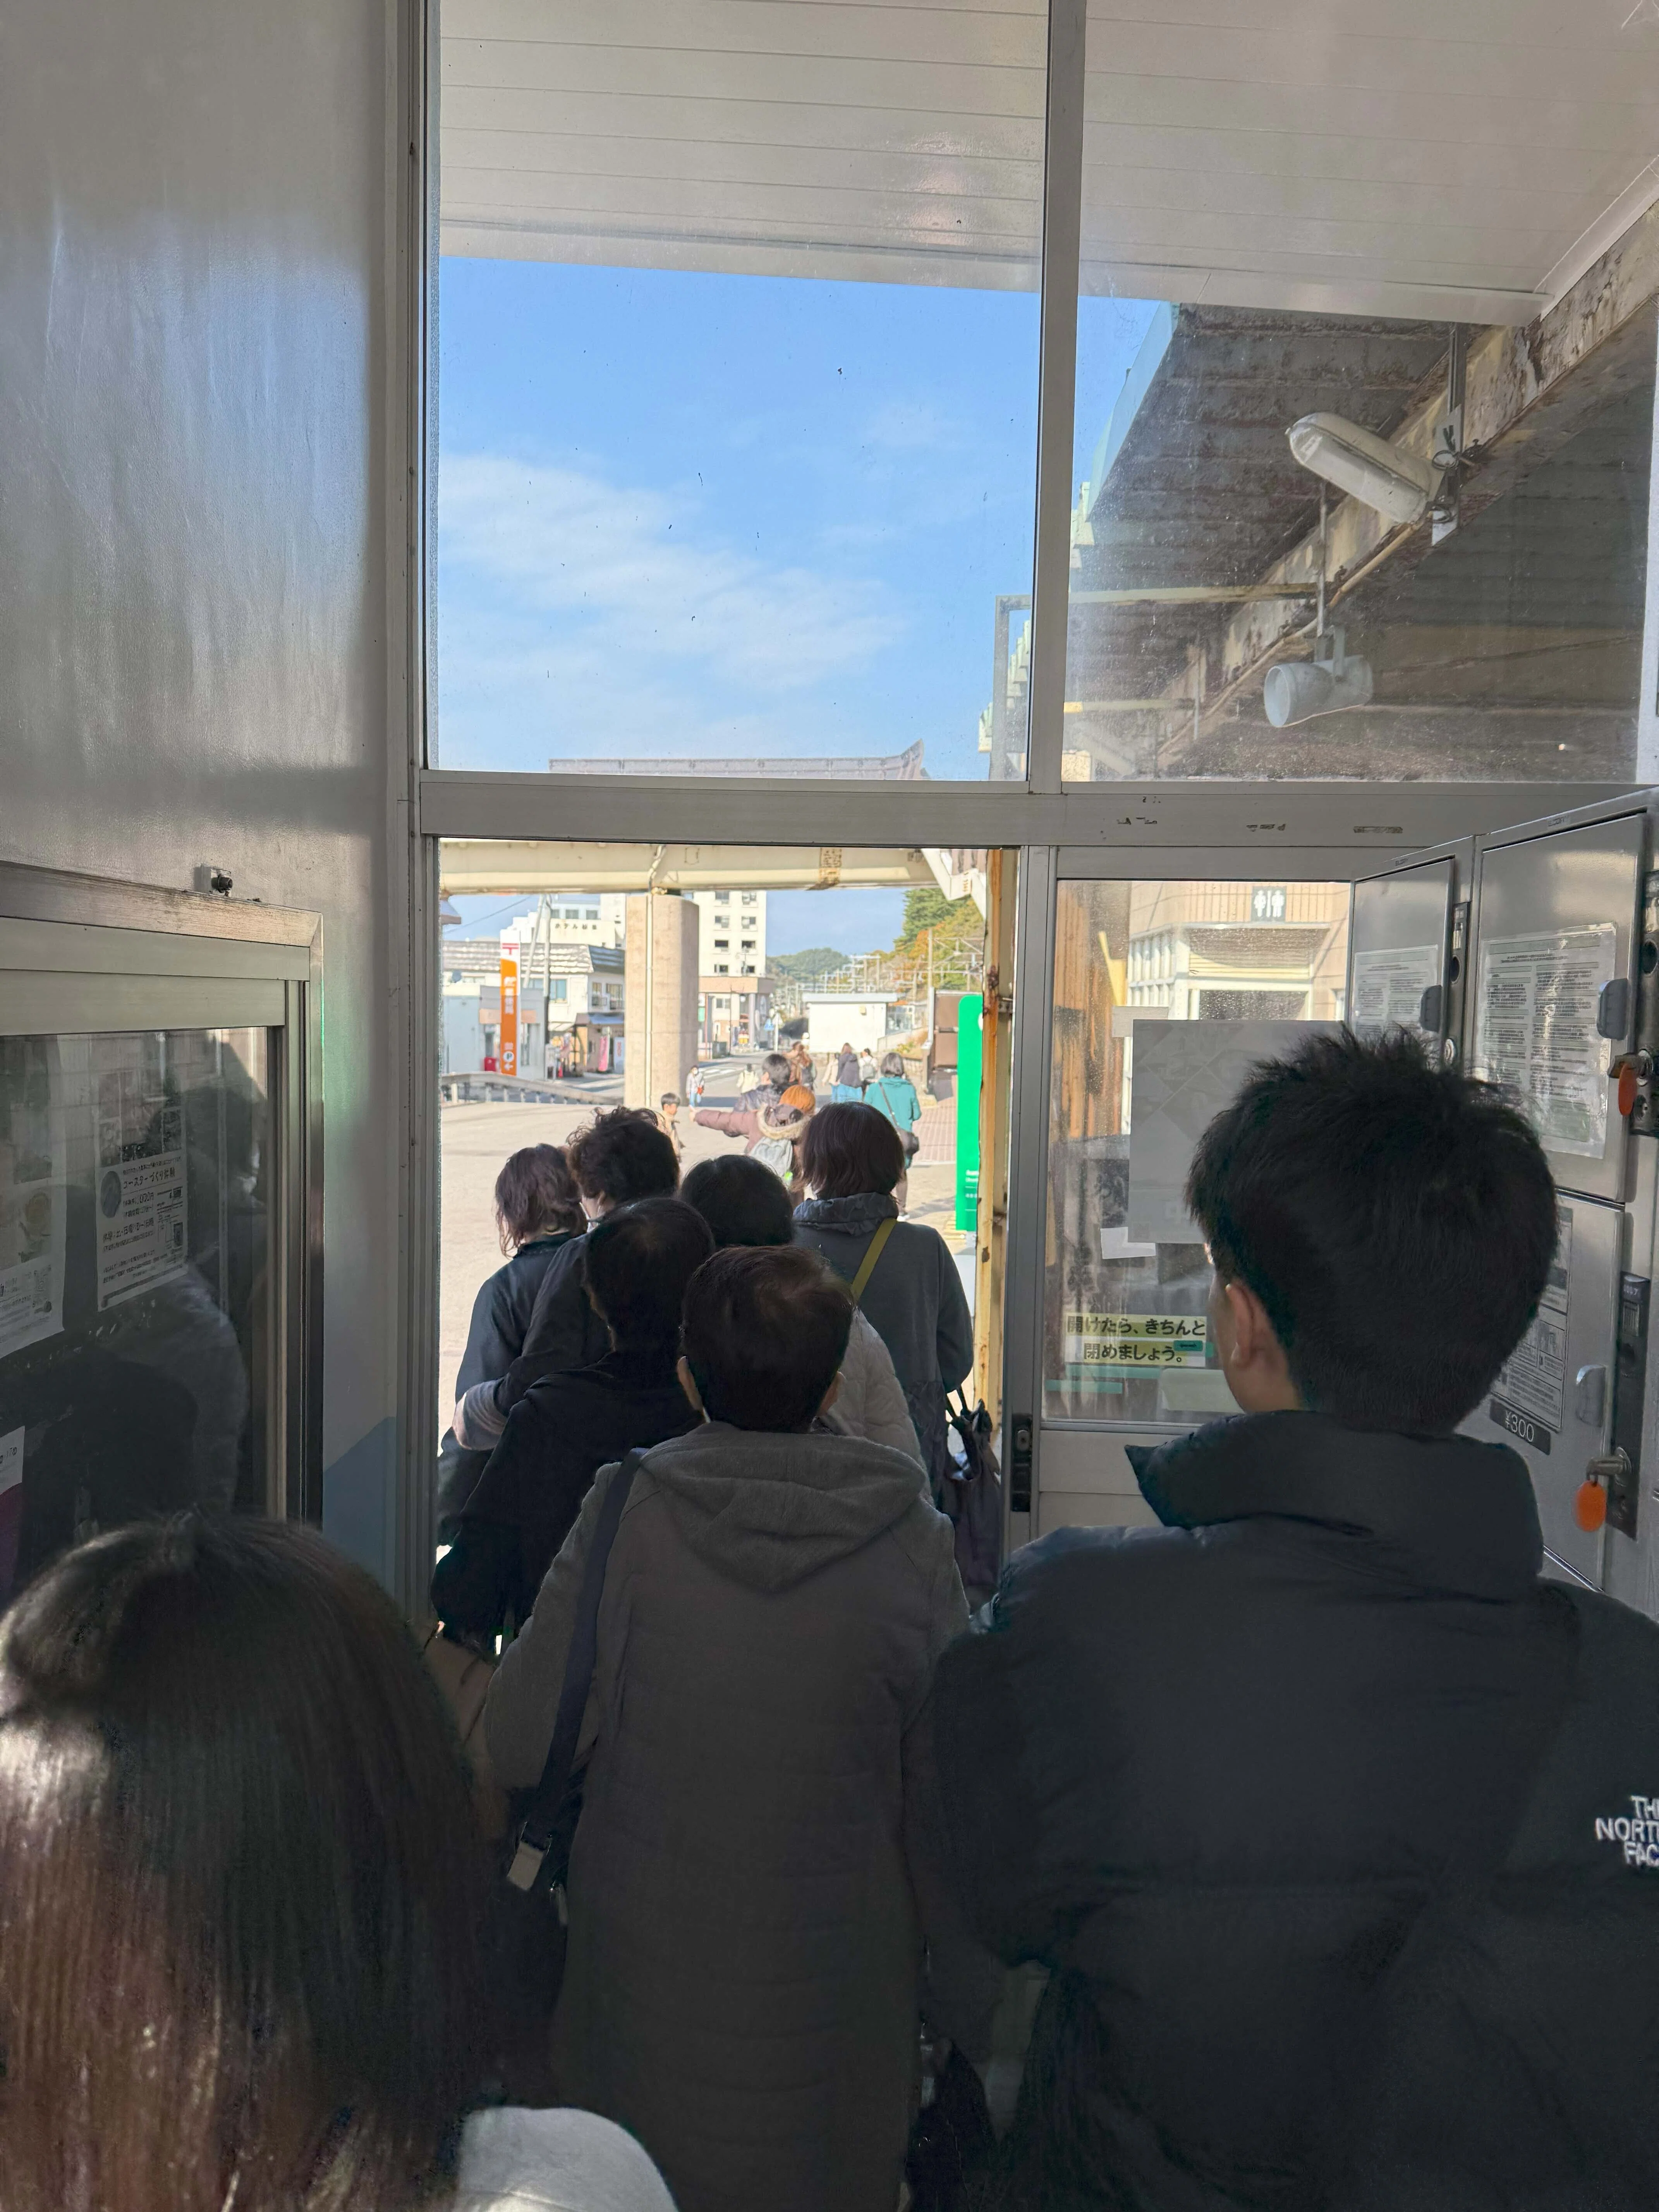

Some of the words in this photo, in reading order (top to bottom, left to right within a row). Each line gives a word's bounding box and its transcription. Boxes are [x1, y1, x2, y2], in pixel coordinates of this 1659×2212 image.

[1067, 1316, 1206, 1336] 開けたら、きちんと
[1084, 1343, 1183, 1363] 閉めましょう。
[1505, 1410, 1534, 1442] ¥300
[1595, 1817, 1659, 1843] NORT
